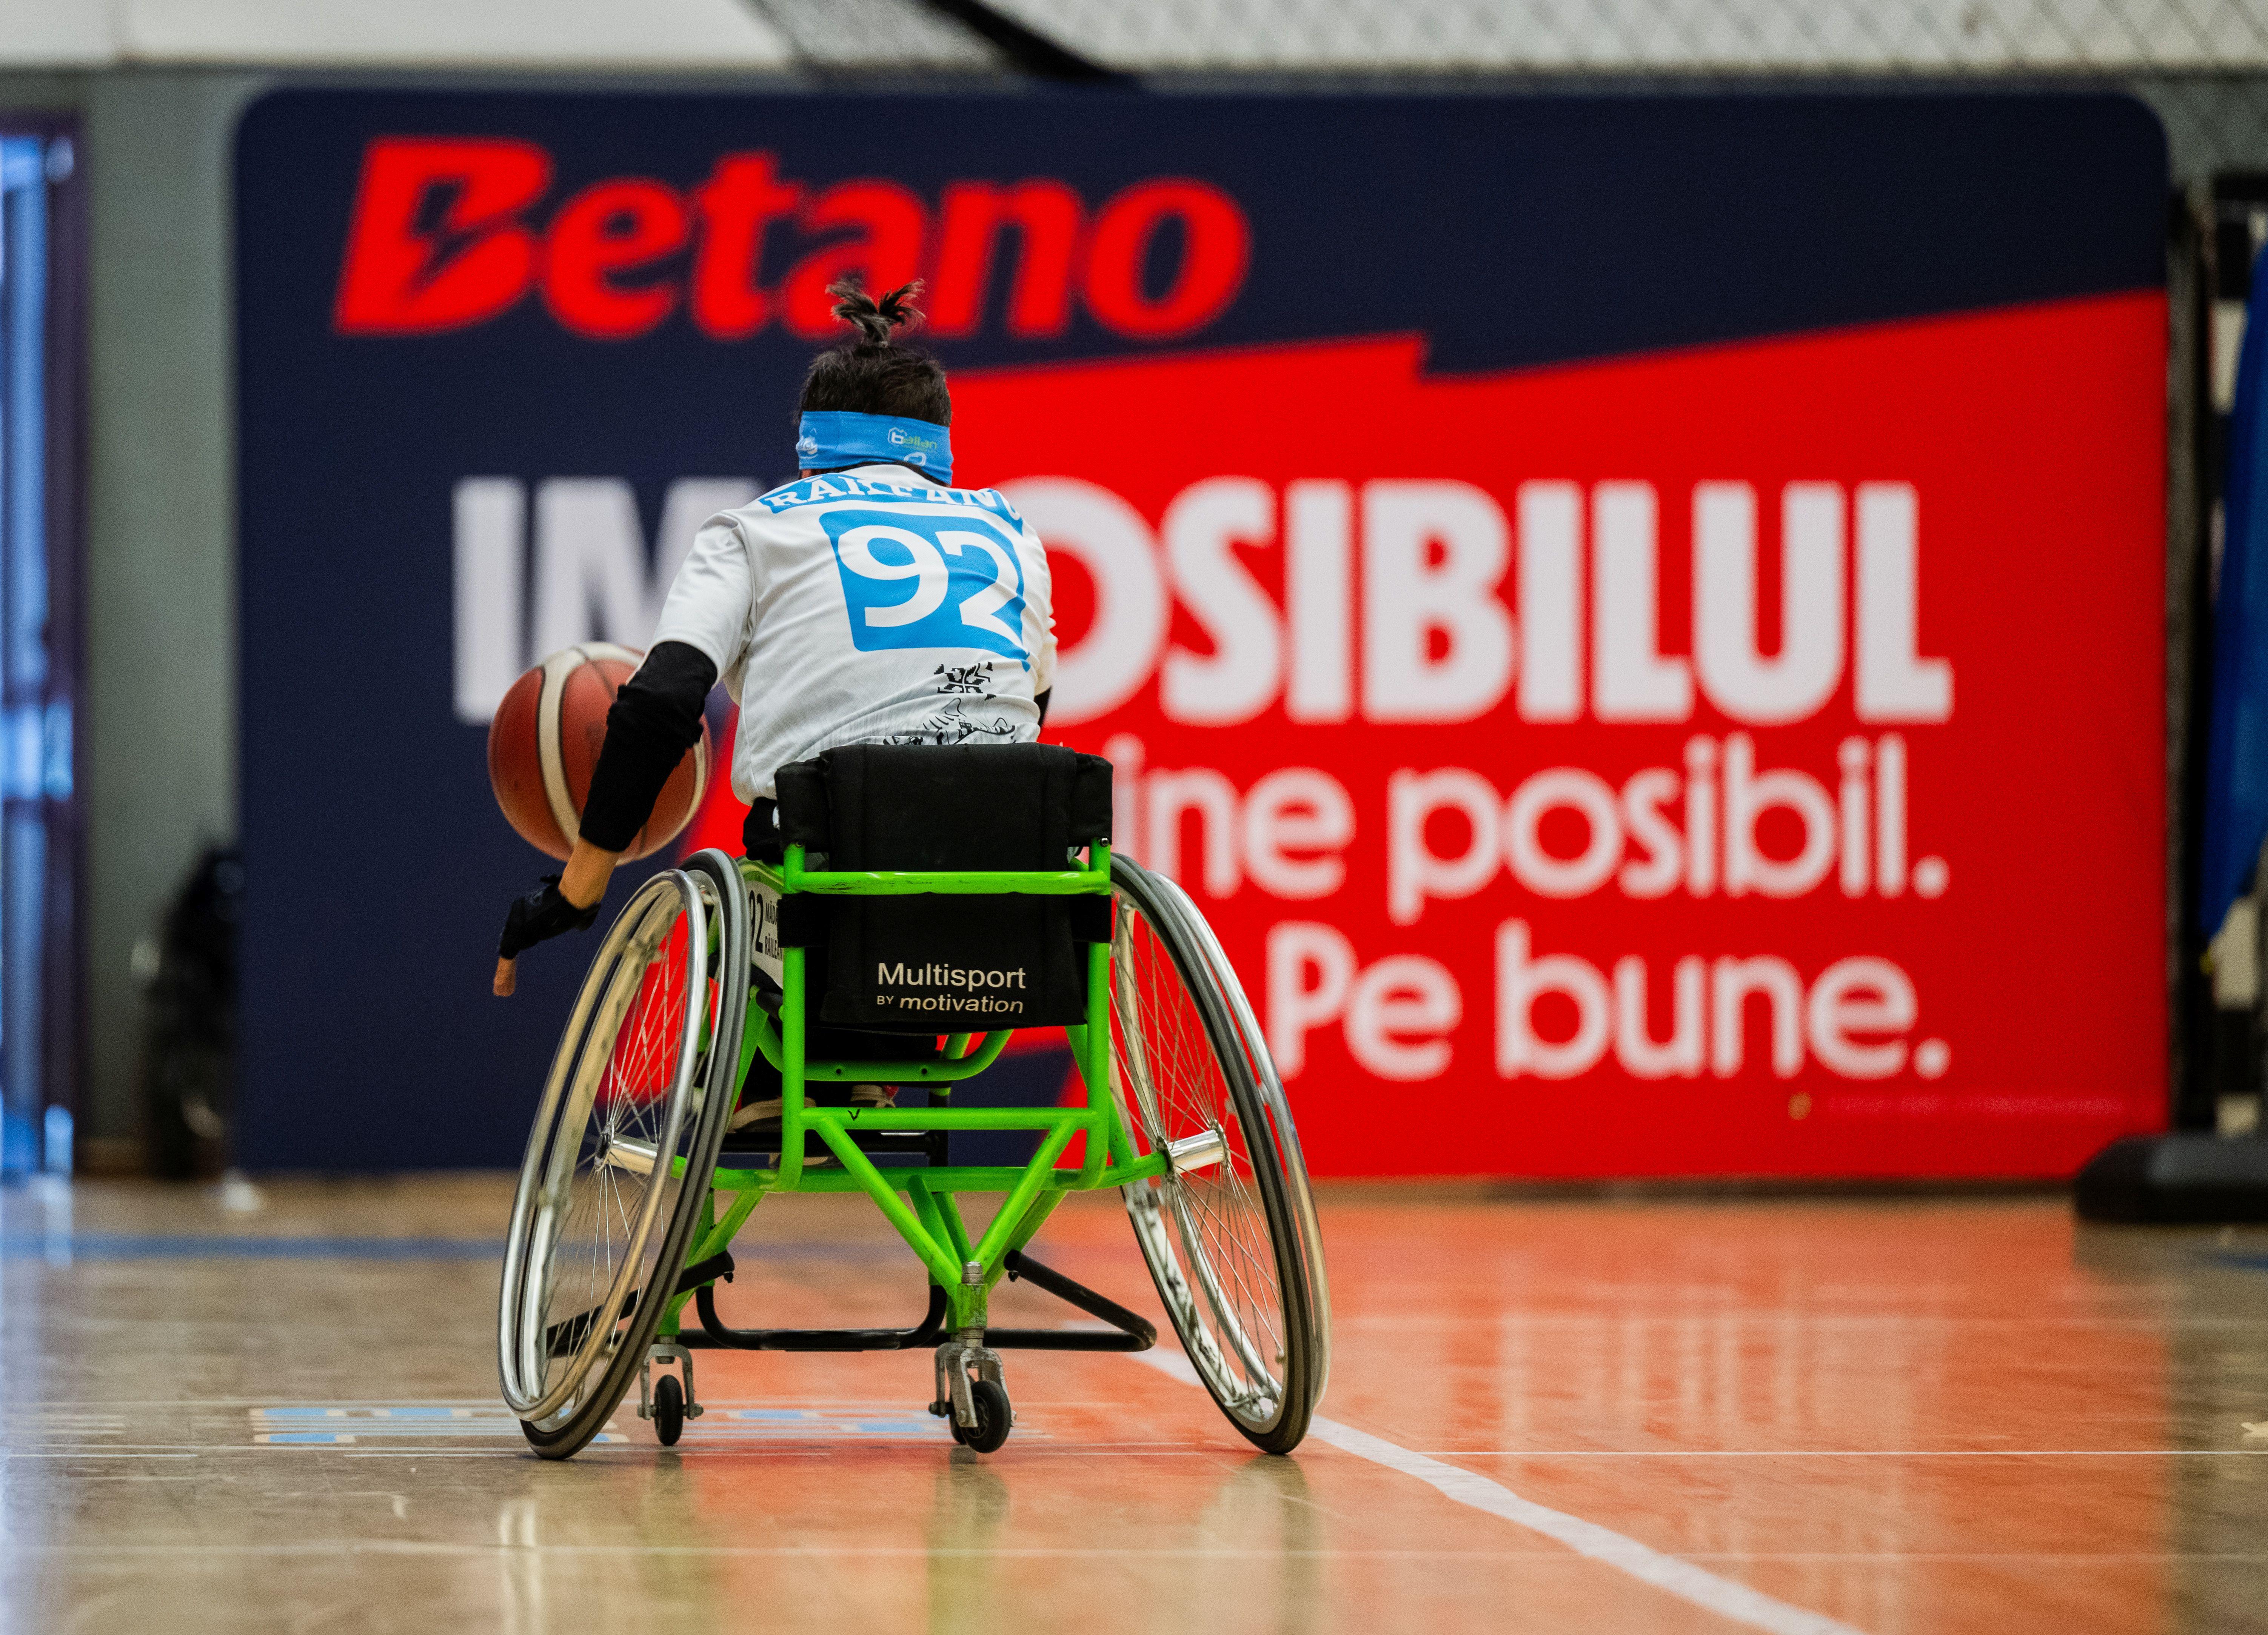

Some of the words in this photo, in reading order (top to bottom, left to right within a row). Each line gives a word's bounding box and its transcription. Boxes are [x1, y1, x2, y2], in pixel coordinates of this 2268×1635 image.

[336, 137, 1250, 338] Betano
[454, 476, 1953, 727] IMOSIBILUL
[838, 525, 1023, 645] 92
[1388, 733, 1949, 923] posibil.
[877, 995, 894, 1005] BY
[899, 994, 1024, 1013] motivation
[878, 962, 1026, 992] Multisport
[1267, 920, 1463, 1079] Pe
[1496, 917, 1950, 1079] bune.
